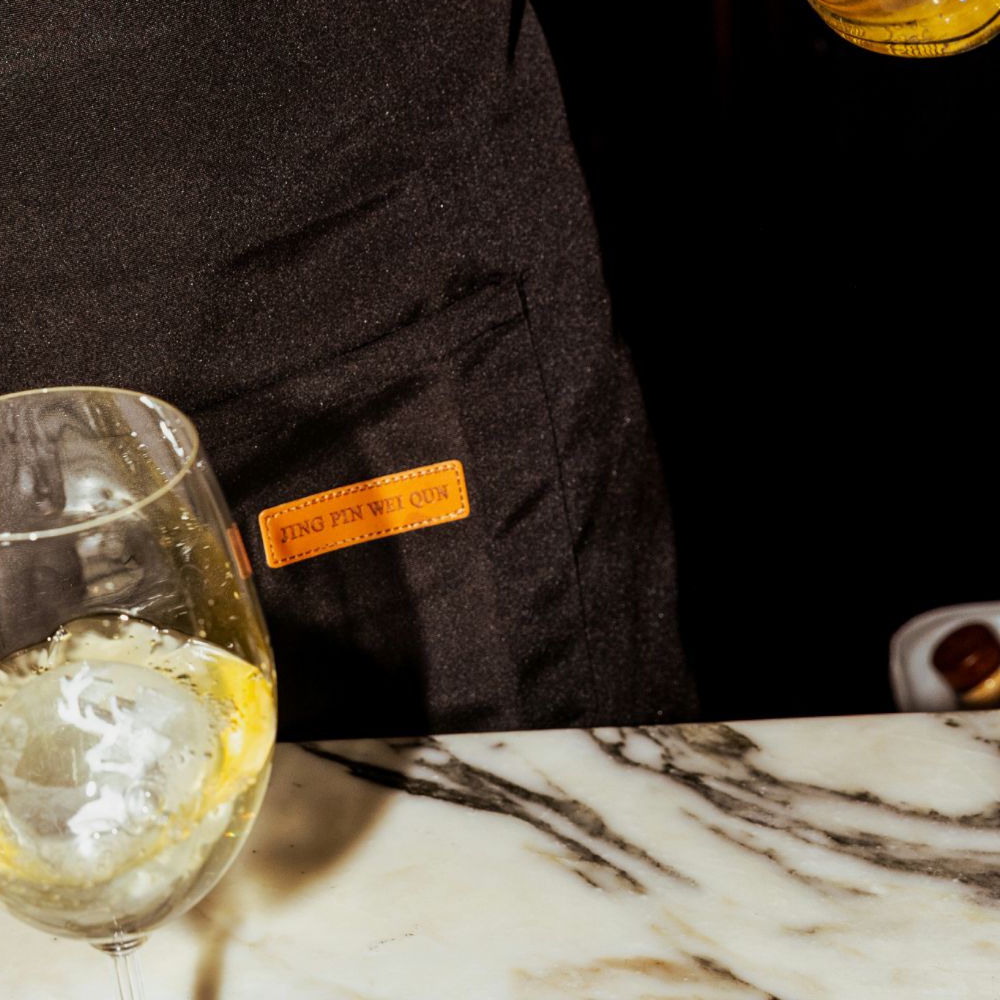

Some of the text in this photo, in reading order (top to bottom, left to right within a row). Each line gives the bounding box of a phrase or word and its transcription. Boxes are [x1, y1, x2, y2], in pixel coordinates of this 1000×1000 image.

[279, 483, 450, 544] JING PIN WEI QUN
